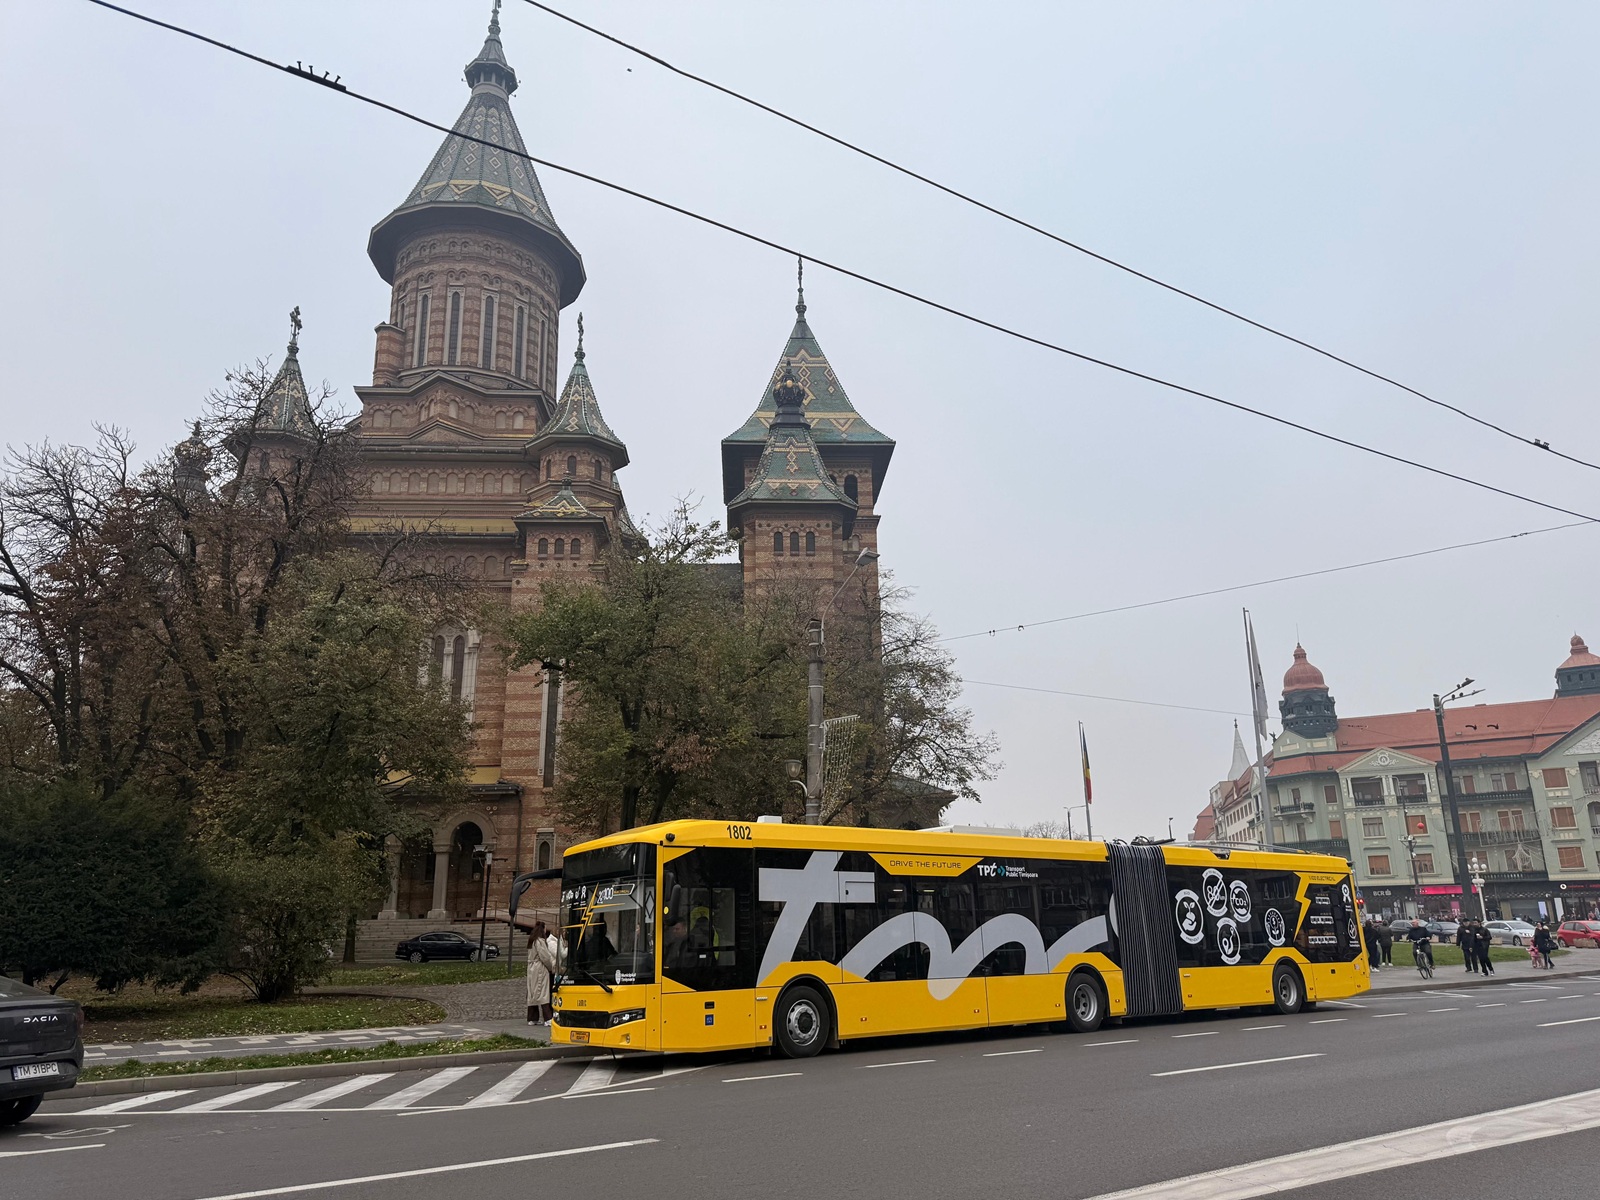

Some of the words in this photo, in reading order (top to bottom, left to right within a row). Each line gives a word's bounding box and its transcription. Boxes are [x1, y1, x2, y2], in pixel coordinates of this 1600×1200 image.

[727, 824, 752, 840] 1802
[1005, 865, 1025, 873] Transport
[18, 1065, 31, 1076] TM
[32, 1063, 57, 1075] 31BPC
